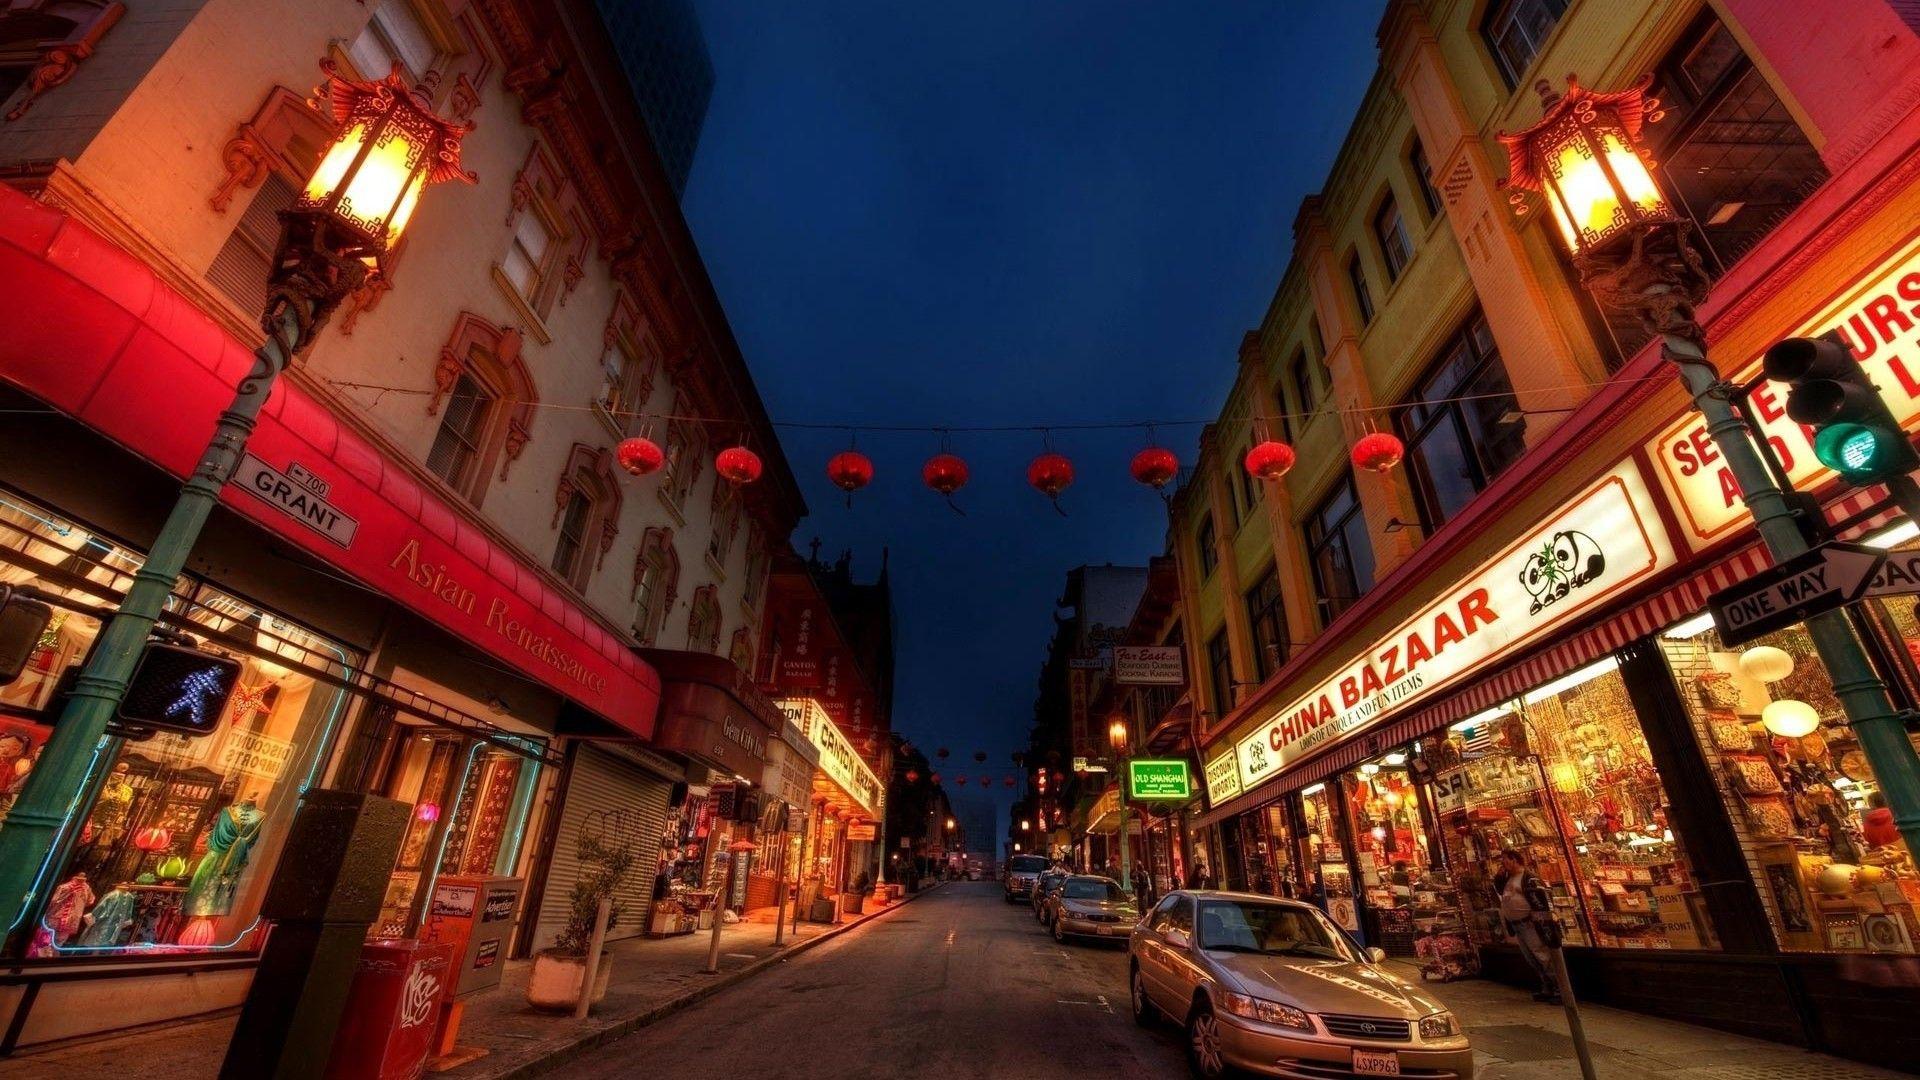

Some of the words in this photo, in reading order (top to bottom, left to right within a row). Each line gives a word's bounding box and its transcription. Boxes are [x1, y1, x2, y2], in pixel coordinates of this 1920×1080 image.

[305, 474, 326, 494] 700
[255, 470, 341, 531] GRANT
[1729, 591, 1776, 626] ONE
[1777, 567, 1828, 605] WAY
[390, 539, 476, 616] Asian
[486, 597, 606, 695] Renaissance
[784, 661, 816, 669] CANTON
[1269, 694, 1337, 752] CHINA
[1339, 588, 1500, 709] BAZAAR
[1316, 727, 1326, 744] OF
[1326, 711, 1354, 738] UNIQUE
[1355, 702, 1372, 721] AND
[1372, 691, 1391, 713] FUN
[1391, 672, 1424, 701] ITEMS
[723, 715, 740, 743] Gem
[741, 726, 754, 757] City
[820, 723, 855, 774] CANTON
[1136, 774, 1149, 783] OLD
[1149, 774, 1184, 783] SHANGHAI
[1207, 756, 1234, 784] DISCOUNT
[1211, 773, 1236, 801] IMPORTS
[1656, 894, 1683, 905] FRONT
[1664, 922, 1692, 933] FRONT
[1356, 1058, 1397, 1073] 4SXP963
